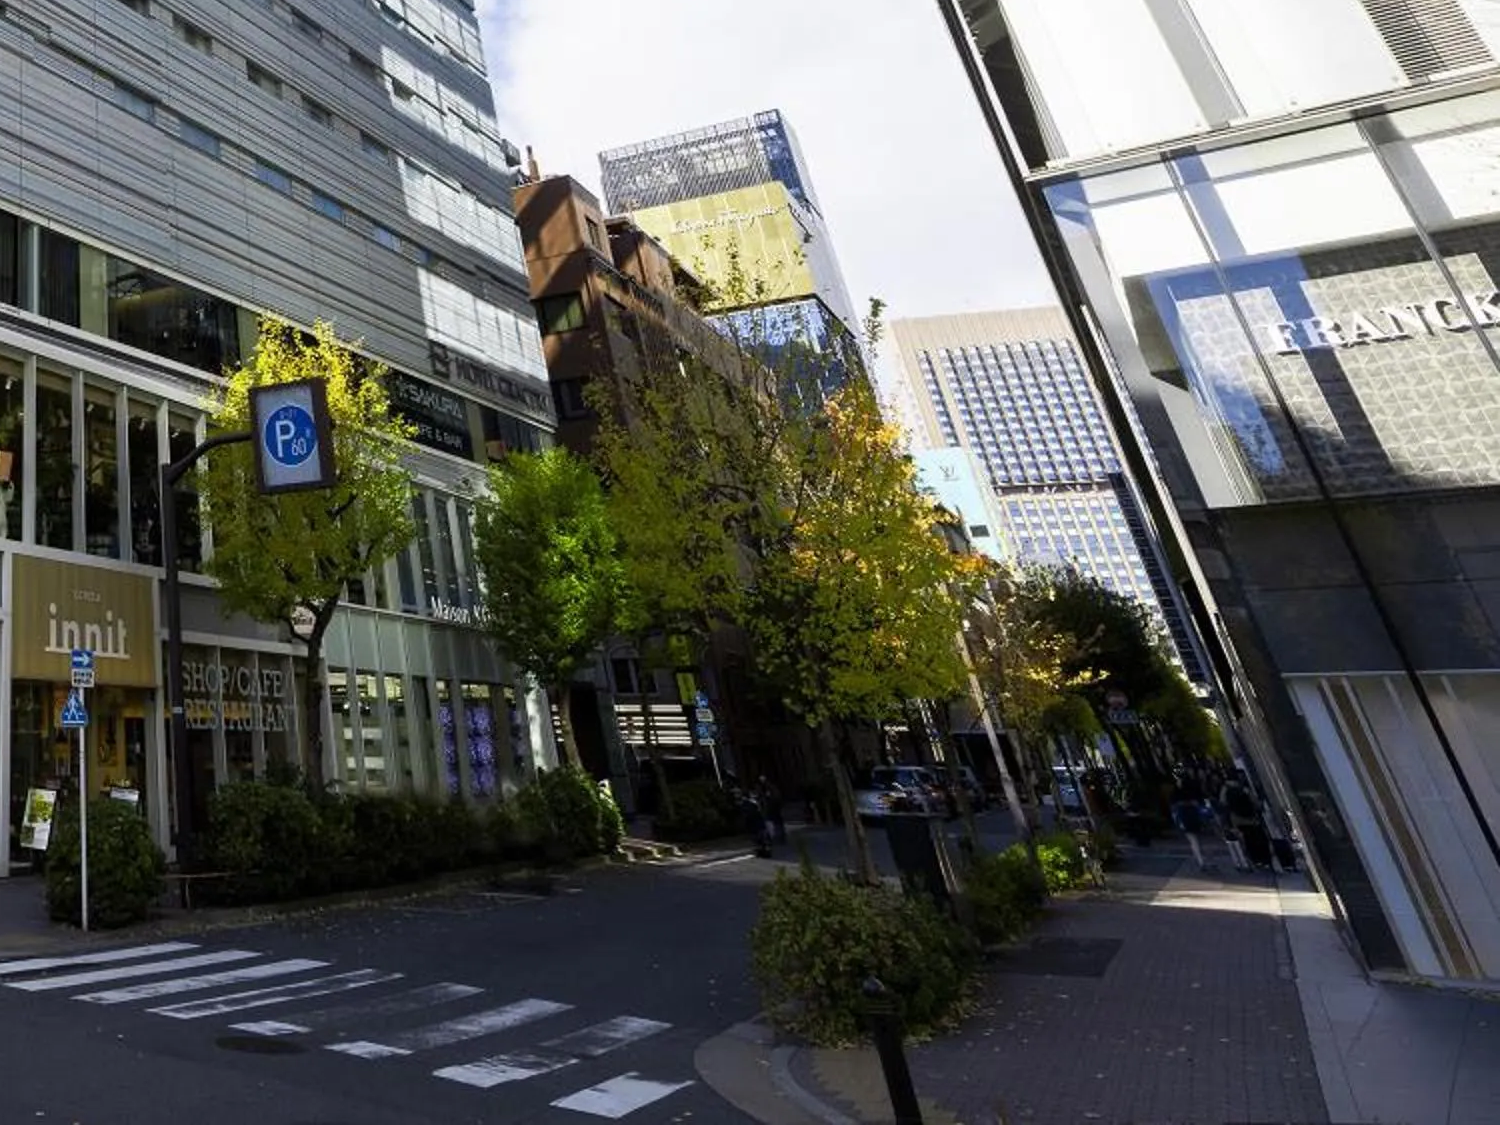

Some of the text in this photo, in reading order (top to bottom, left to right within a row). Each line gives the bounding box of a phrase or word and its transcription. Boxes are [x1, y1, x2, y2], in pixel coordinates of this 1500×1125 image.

[275, 419, 308, 459] P 60
[44, 602, 131, 659] innit
